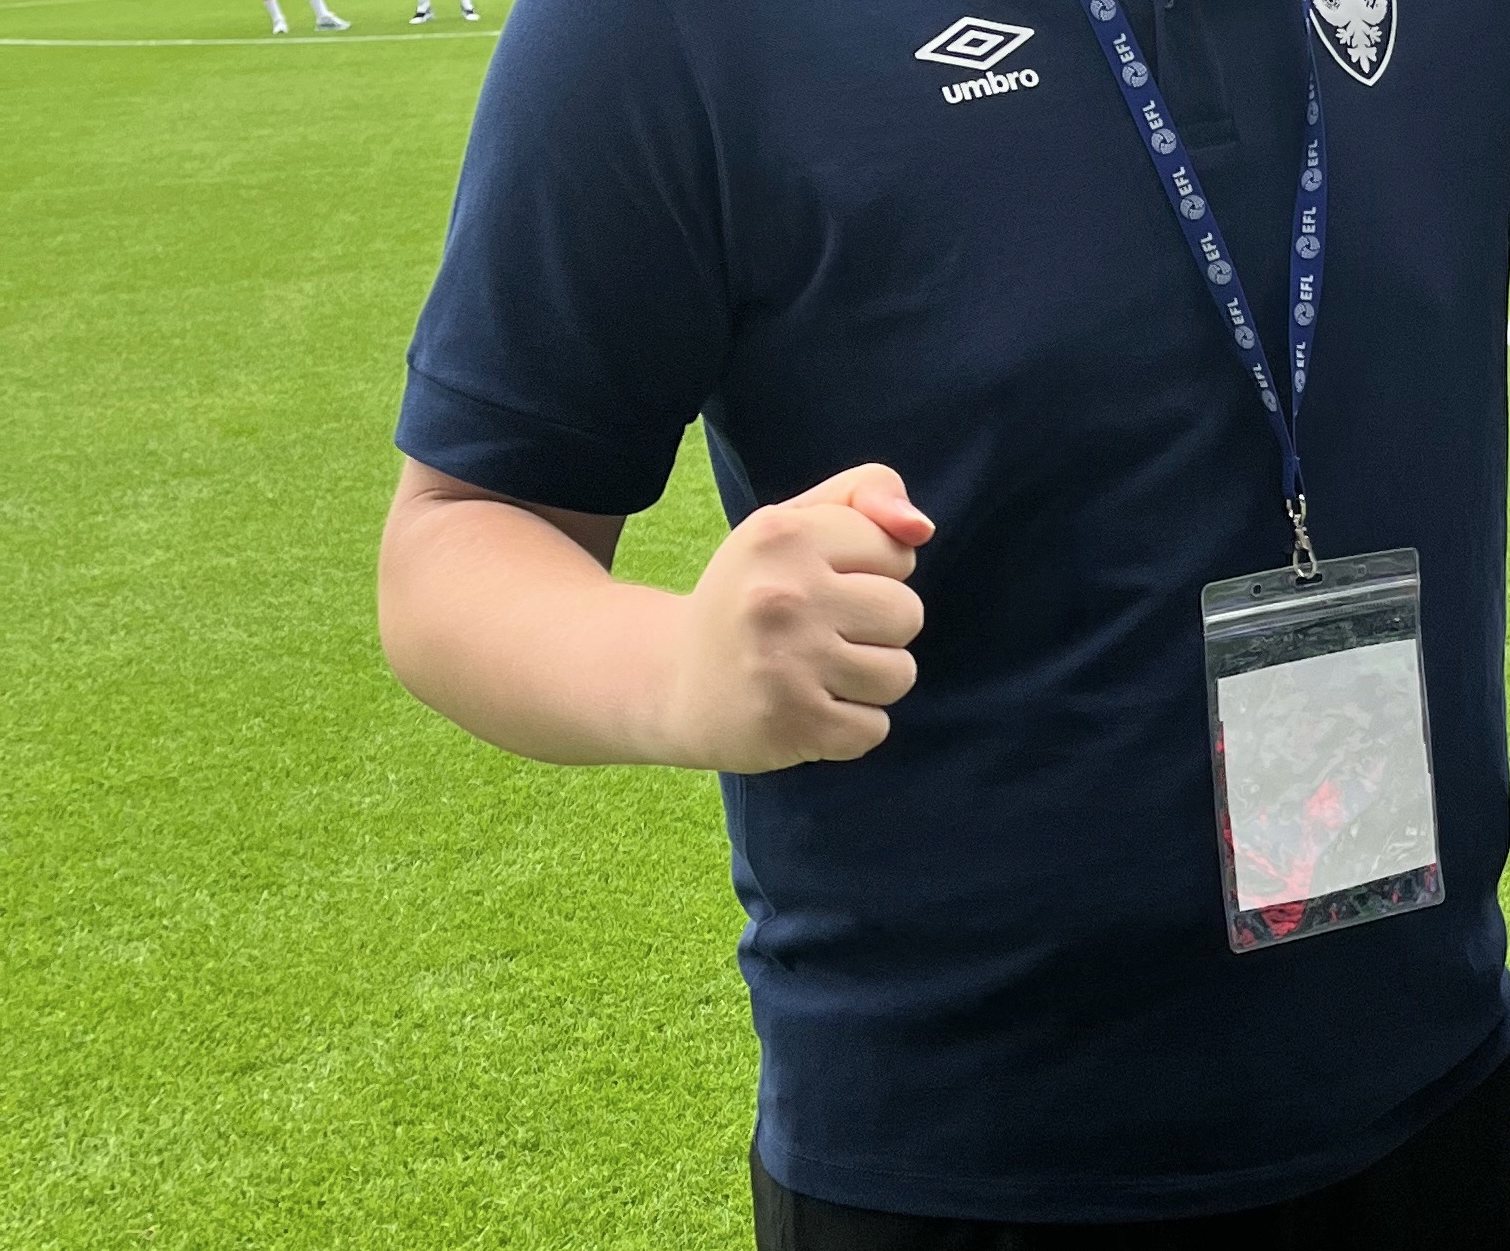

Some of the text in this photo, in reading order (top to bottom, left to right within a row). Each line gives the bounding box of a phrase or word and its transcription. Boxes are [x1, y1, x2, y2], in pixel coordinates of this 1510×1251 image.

[1113, 33, 1135, 64] EFL
[942, 69, 1040, 104] umbro
[1142, 100, 1164, 130] EFL
[1307, 139, 1319, 167] EFL
[1173, 166, 1193, 196] EFL
[1302, 206, 1317, 233] EFL
[1200, 232, 1220, 261] EFL
[1300, 274, 1314, 301] EFL
[1227, 297, 1245, 325] EFL
[1295, 341, 1306, 368] EFL
[1253, 363, 1268, 388] EFL
